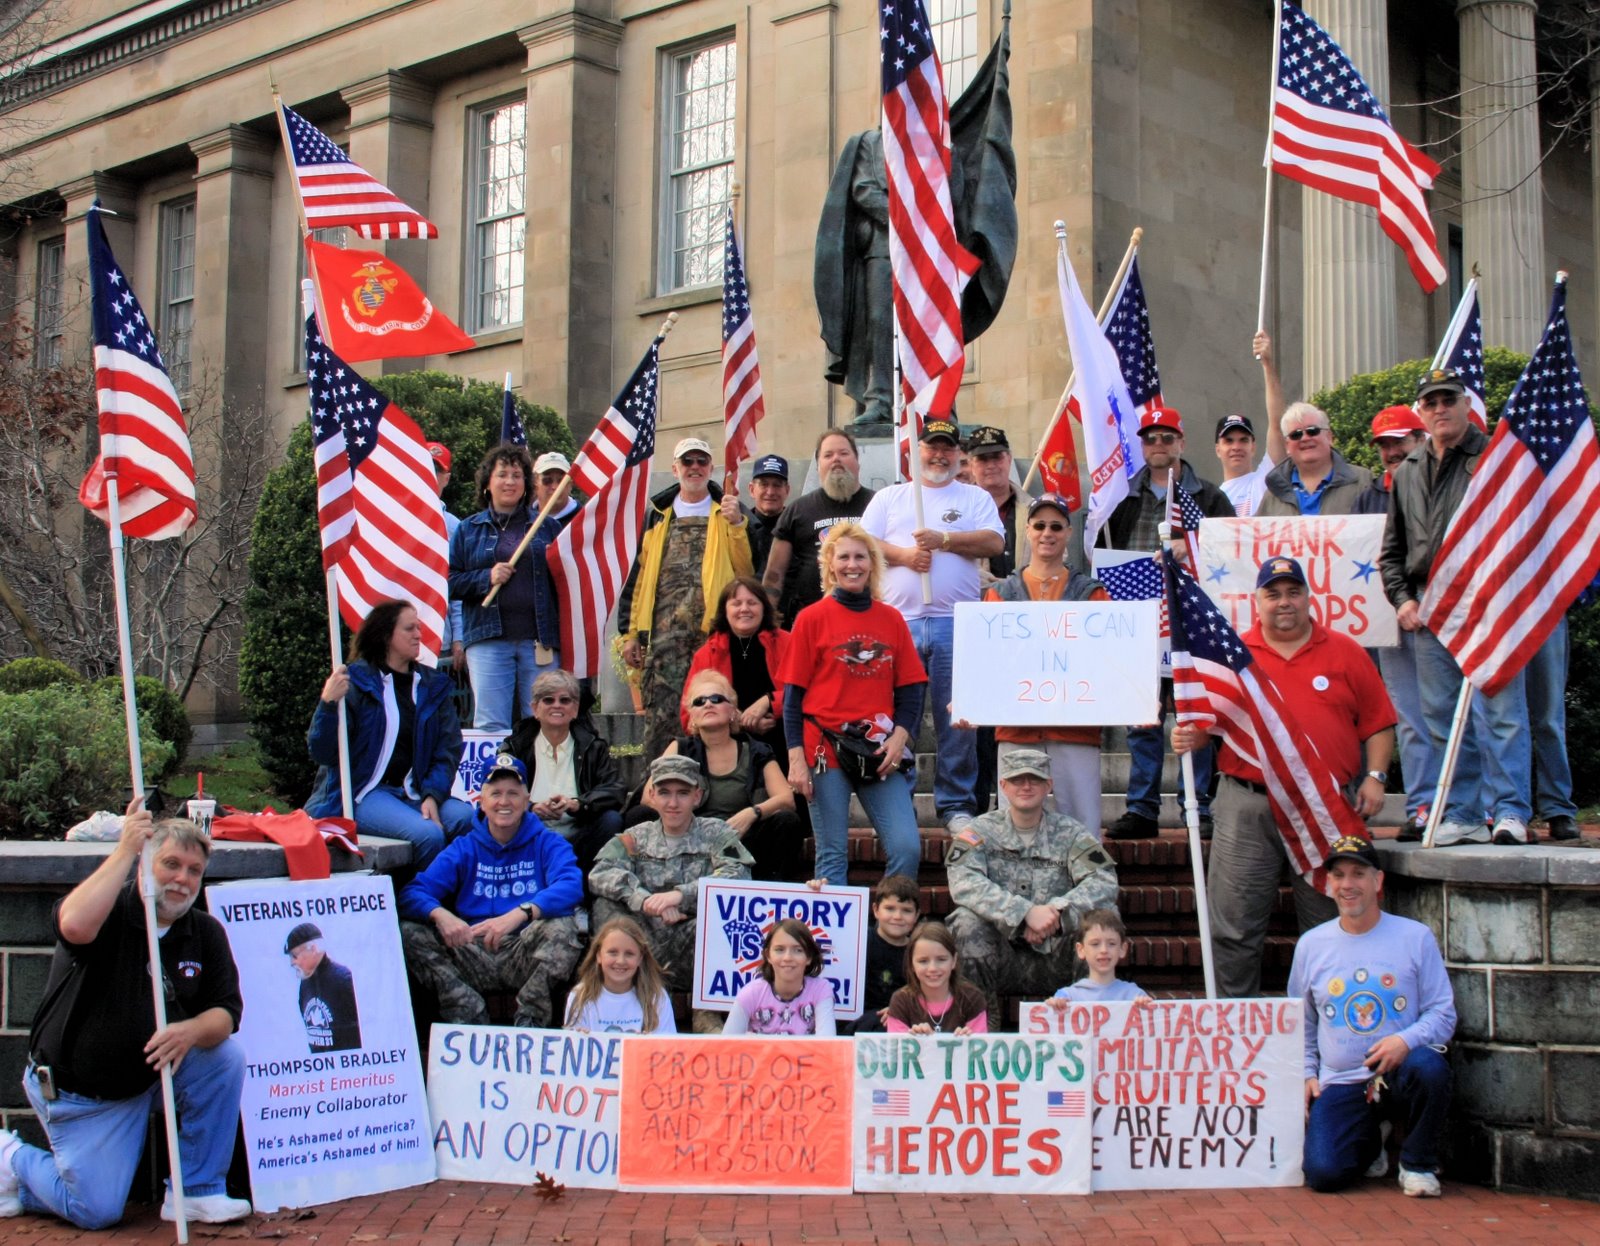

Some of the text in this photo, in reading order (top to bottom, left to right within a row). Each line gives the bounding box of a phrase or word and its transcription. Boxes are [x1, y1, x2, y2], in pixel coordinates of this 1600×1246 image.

[1225, 518, 1347, 560] THANK
[979, 611, 1136, 639] YES WE CAN
[1041, 650, 1067, 672] IN
[1018, 680, 1096, 702] 2012
[221, 893, 387, 923] VETERANS FOR PEACE
[716, 894, 853, 928] VICTORY
[731, 932, 761, 961] IS
[709, 970, 851, 1006] ANR!
[1028, 1002, 1297, 1037] STOP ATTACKING
[247, 1049, 407, 1079] THOMPSON BRADLEY
[440, 1031, 619, 1079] SURRENDE
[649, 1052, 814, 1080] PROUD OF
[857, 1040, 1085, 1082] OUR TROOPS
[1098, 1037, 1266, 1071] MILITARY
[269, 1072, 395, 1098] Marxist Emeritus
[642, 1083, 837, 1113] OUR TROOPS
[1094, 1072, 1267, 1105] CRUITERS
[260, 1092, 408, 1122] Enemy Collaborator
[480, 1081, 619, 1122] IS NOT
[927, 1084, 1021, 1124] ARE
[258, 1119, 415, 1150] He's Ashamed of America?
[642, 1113, 807, 1142] AND THEIR
[1114, 1106, 1171, 1136] ARE
[1193, 1105, 1264, 1137] NOT
[258, 1137, 420, 1170] America's Ashamed of him!
[434, 1120, 485, 1159] AN
[867, 1127, 1063, 1176] HEROES
[674, 1145, 816, 1173] MISSION
